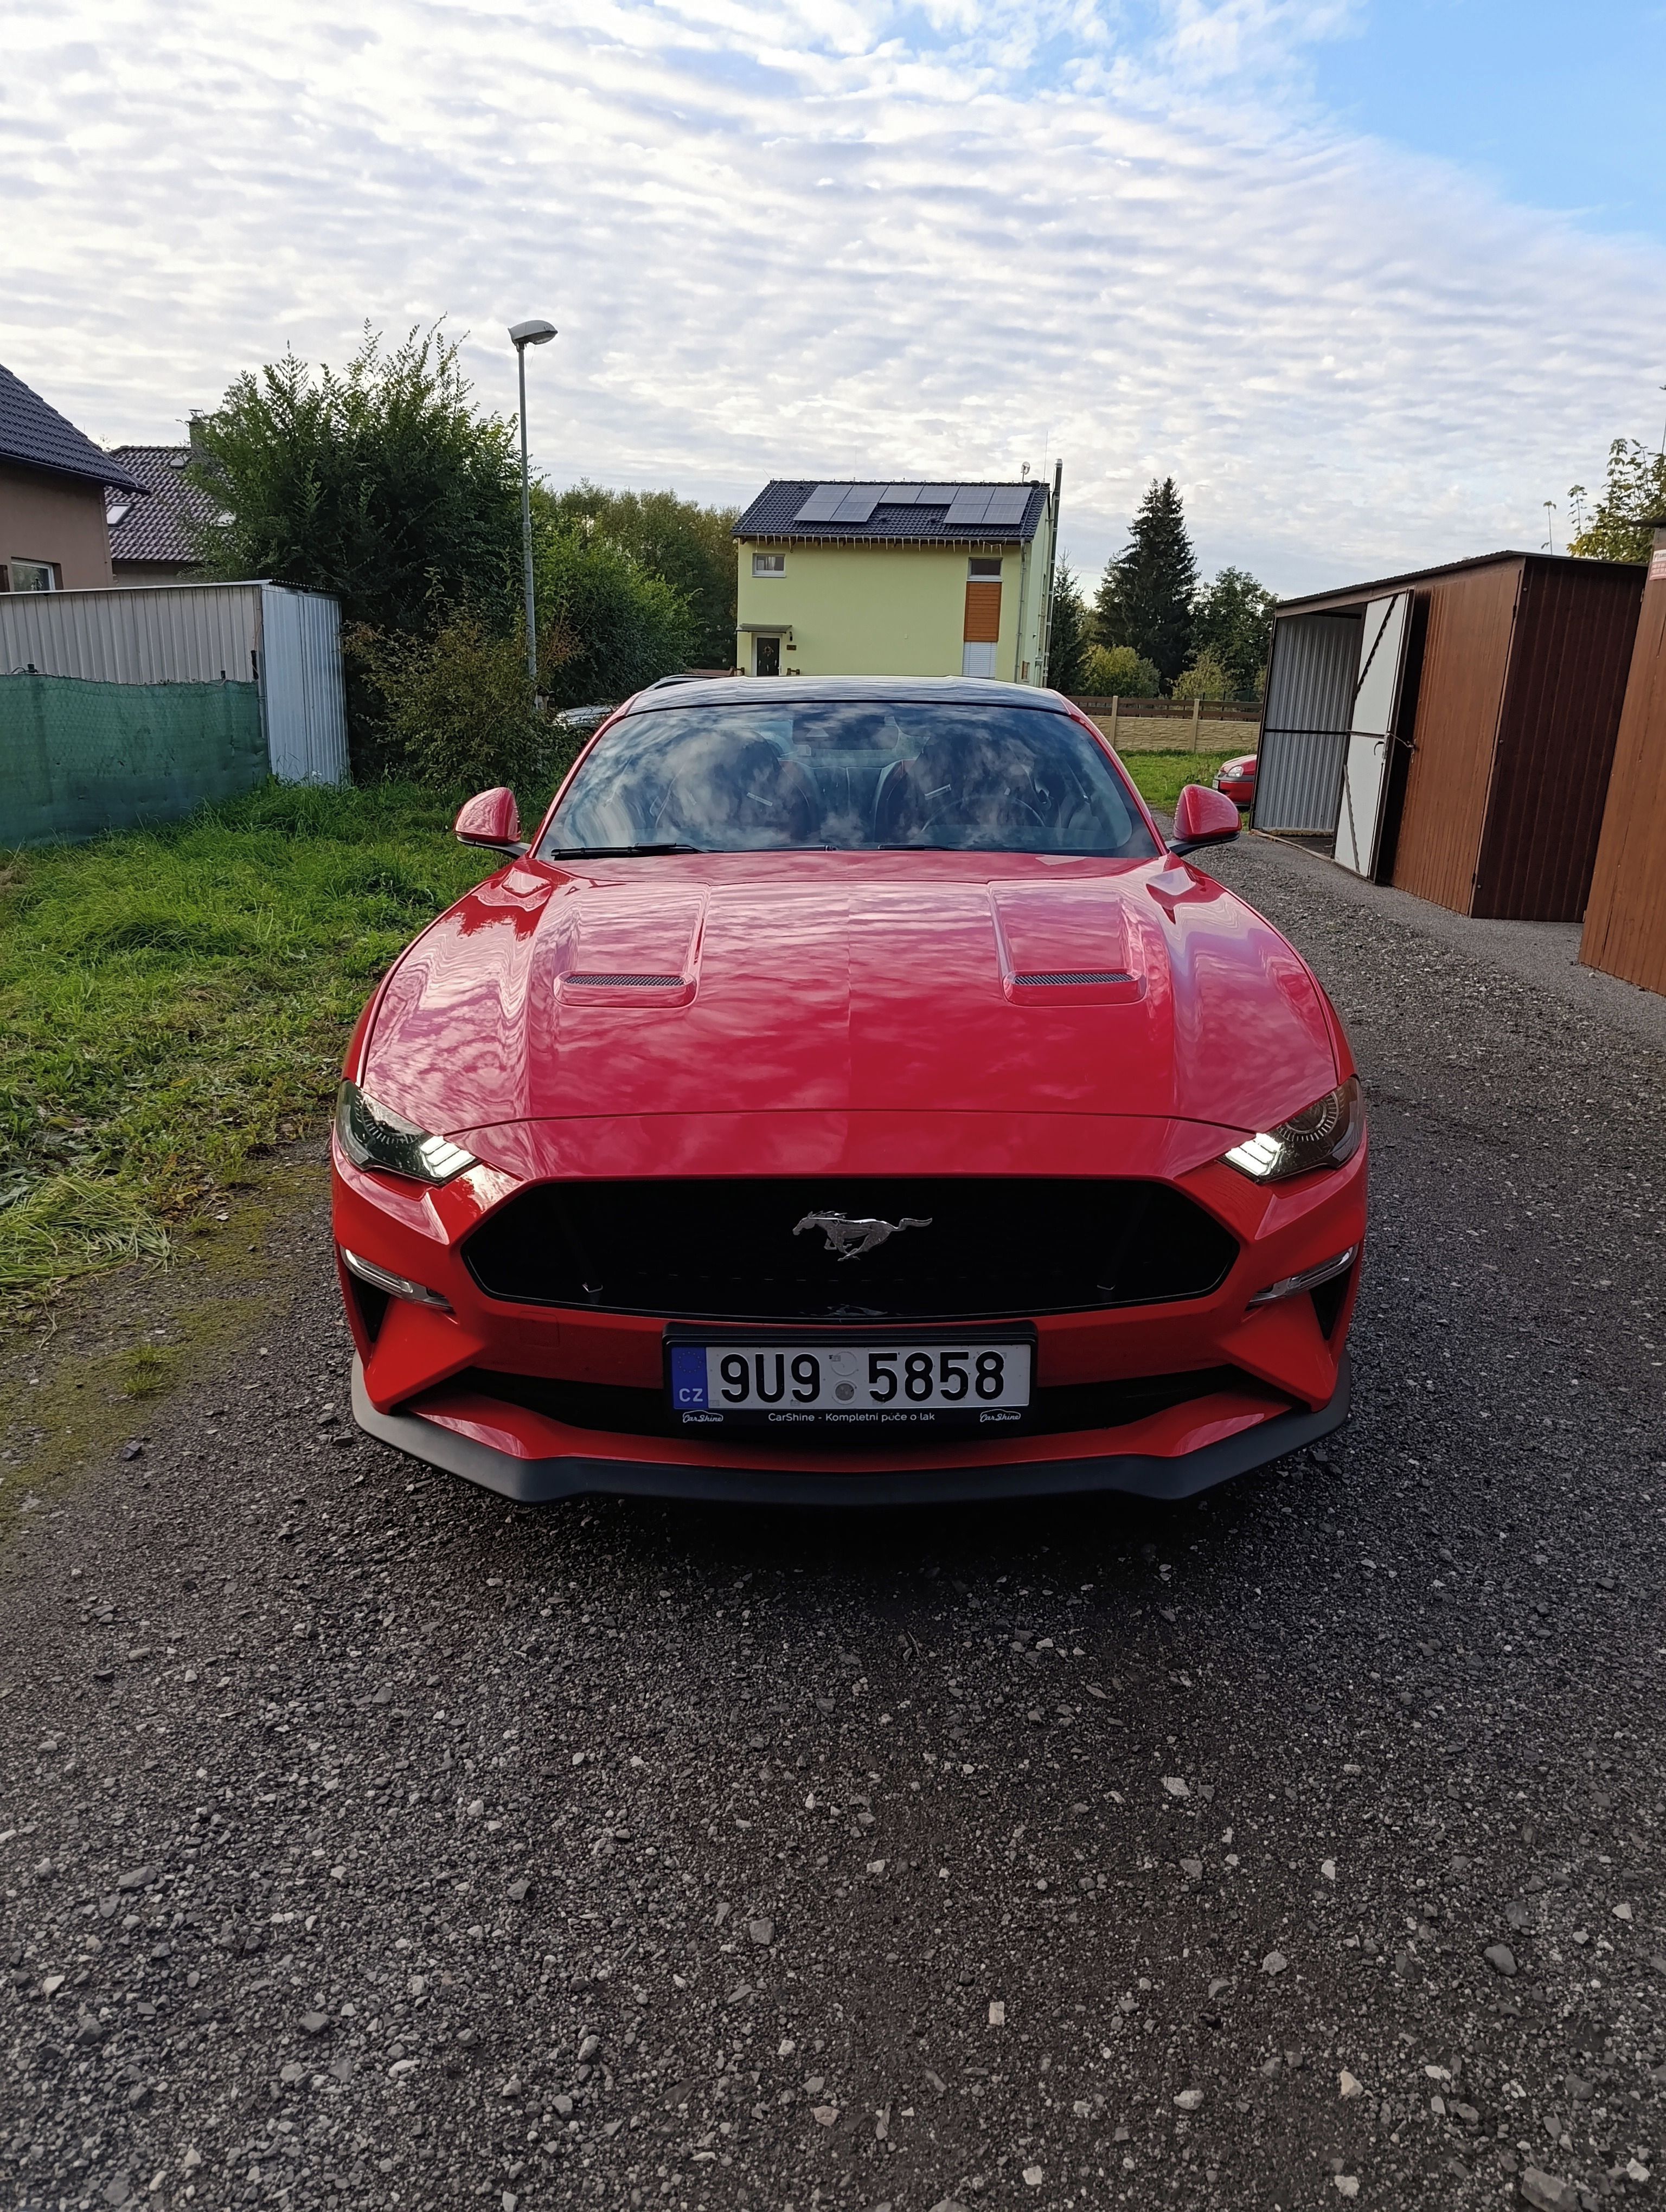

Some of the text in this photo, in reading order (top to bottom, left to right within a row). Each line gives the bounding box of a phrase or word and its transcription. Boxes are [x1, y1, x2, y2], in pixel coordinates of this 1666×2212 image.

[720, 1351, 1005, 1403] 9U9 5858
[679, 1388, 703, 1402] CZ
[768, 1413, 815, 1422] CarShine
[825, 1412, 878, 1423] Kompletní
[920, 1412, 935, 1420] lak
